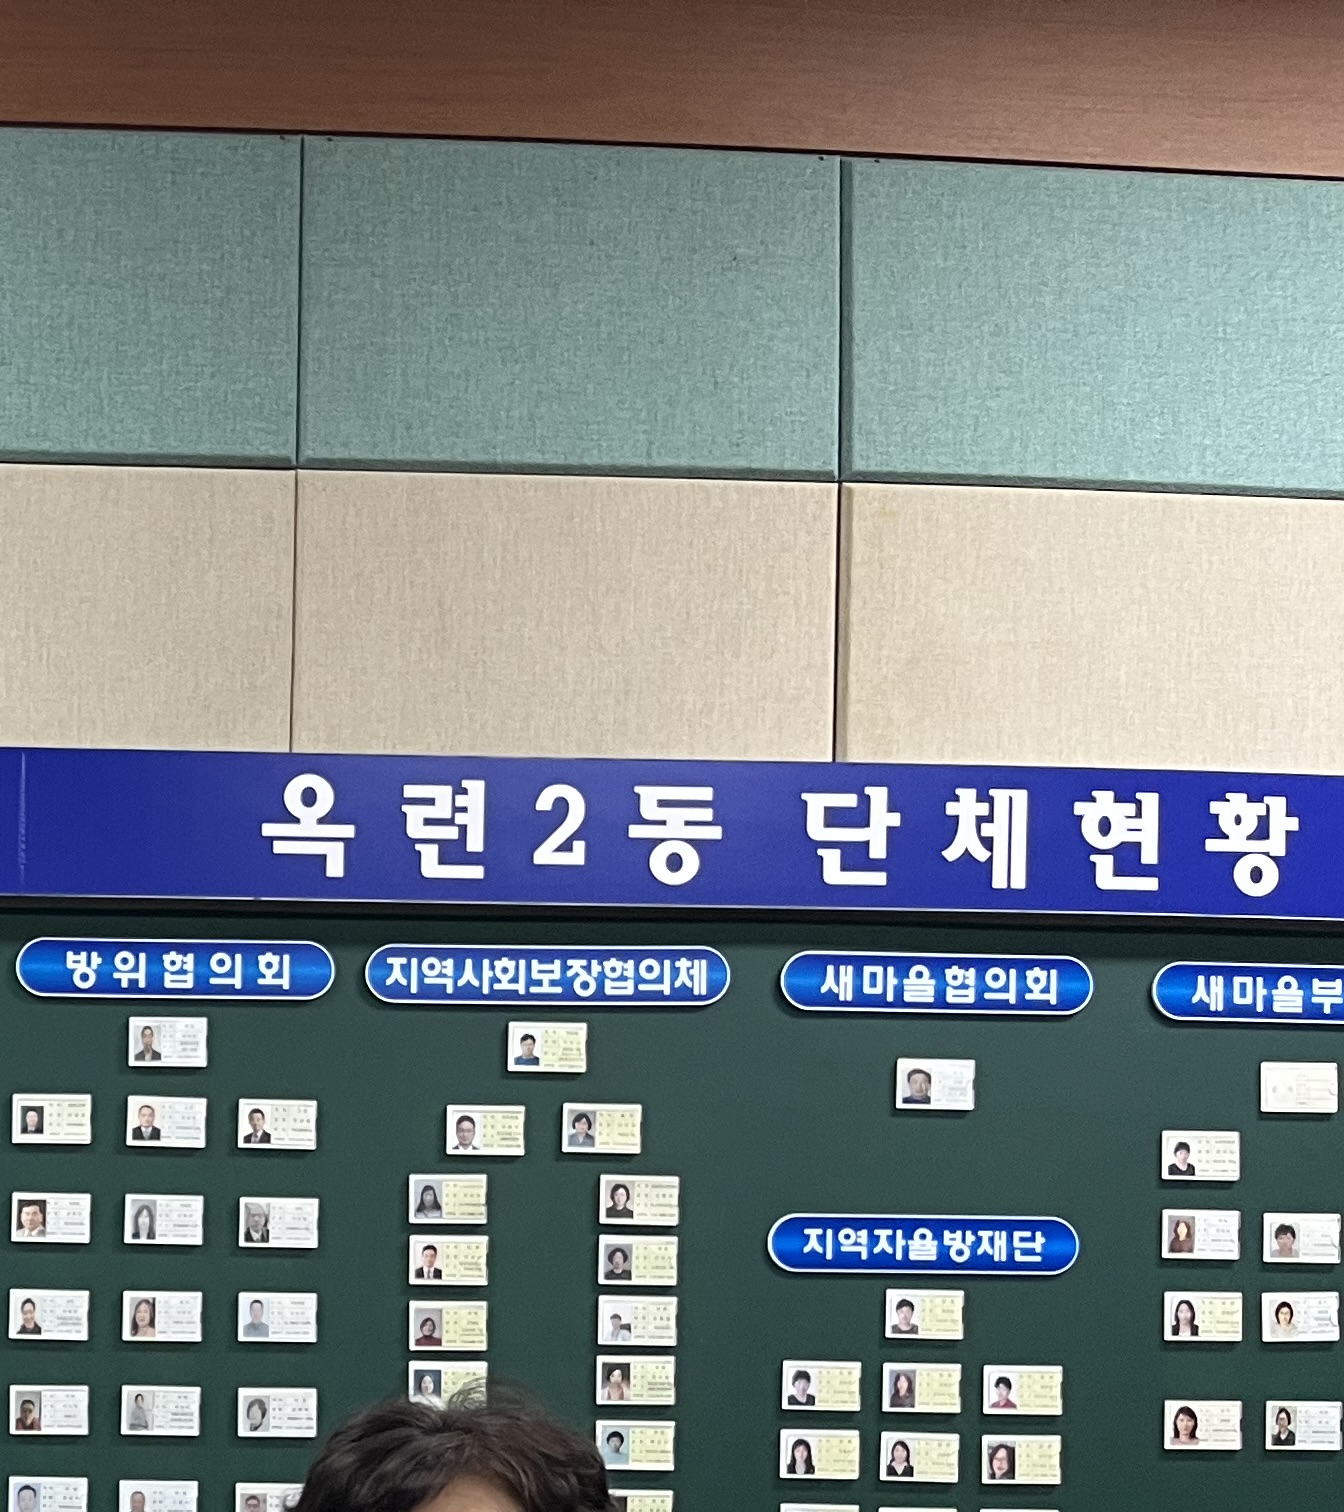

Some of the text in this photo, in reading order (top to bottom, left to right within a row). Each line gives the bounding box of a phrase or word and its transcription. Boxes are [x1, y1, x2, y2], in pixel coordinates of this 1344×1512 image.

[260, 772, 1300, 898] 옥련2동 단체현황
[65, 949, 292, 990] 방위협의회
[385, 956, 708, 997] 지역사회보장협의체
[820, 962, 1058, 1005] 새마을협의회
[1191, 974, 1344, 1015] 새마을부
[803, 1227, 1047, 1264] 지역자율방재단
